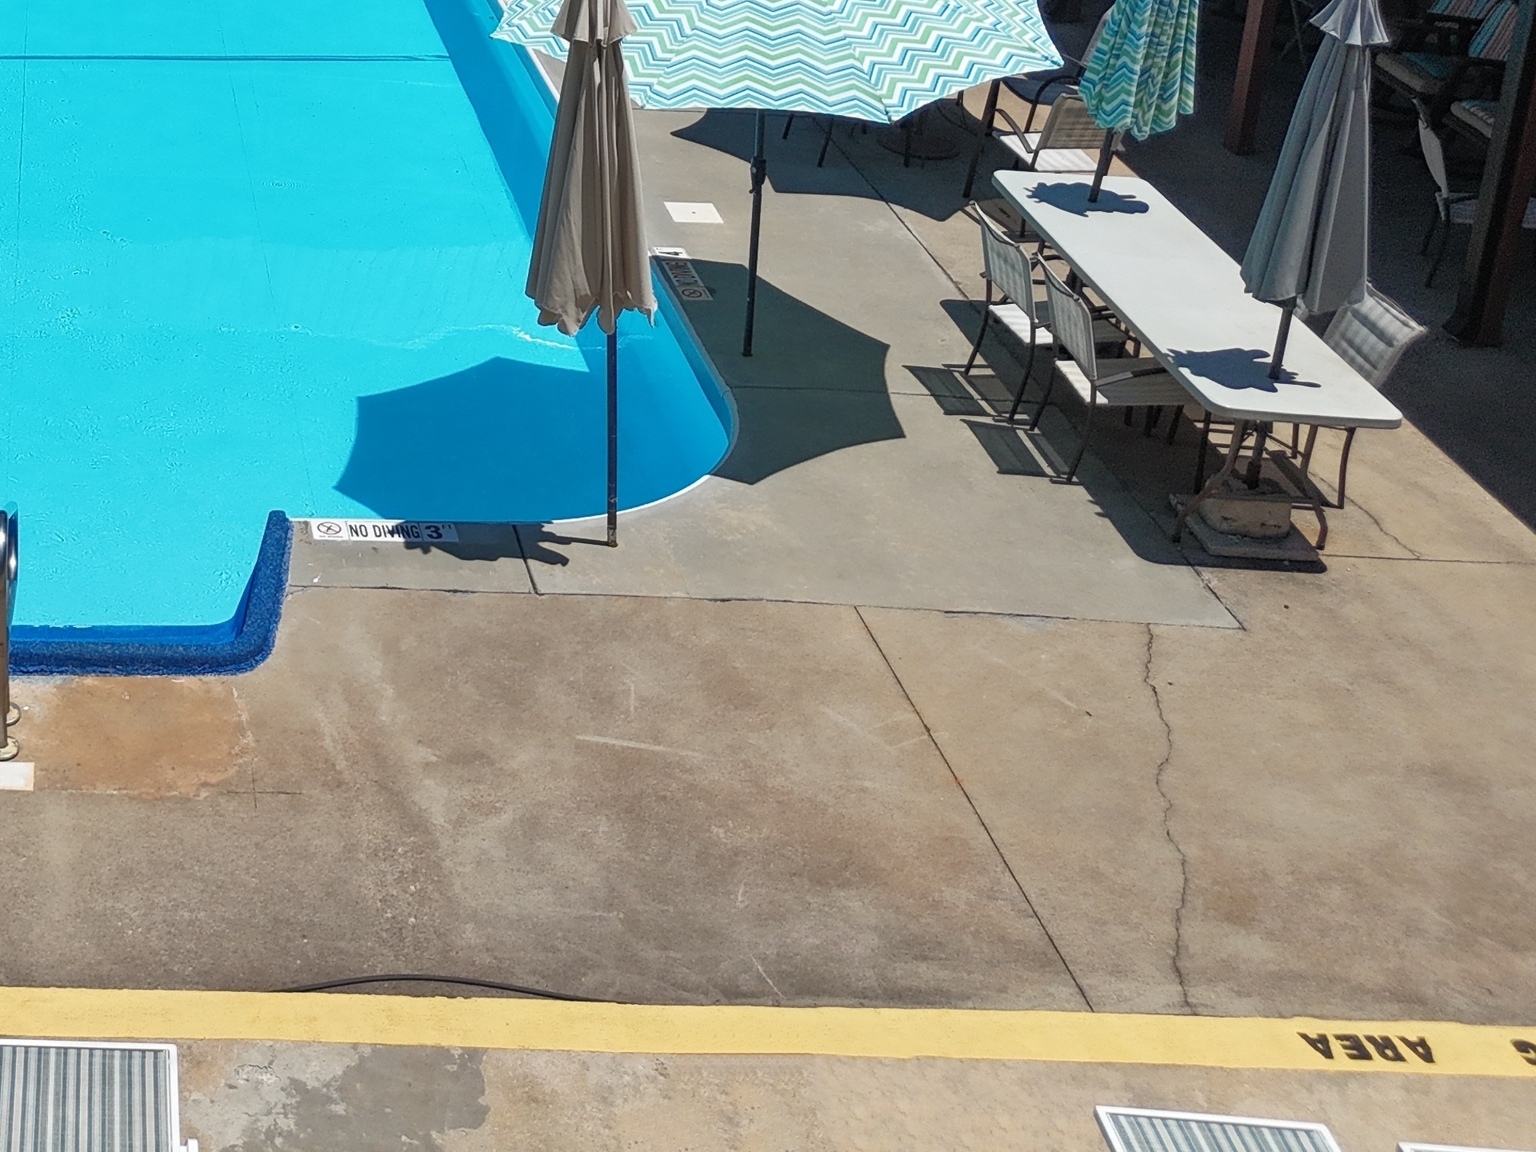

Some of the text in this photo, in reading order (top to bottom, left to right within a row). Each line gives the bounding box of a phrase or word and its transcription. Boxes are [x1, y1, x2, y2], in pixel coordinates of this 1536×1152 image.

[349, 524, 420, 539] NO DIVING
[424, 524, 443, 539] 3
[1296, 1031, 1436, 1064] AREA
